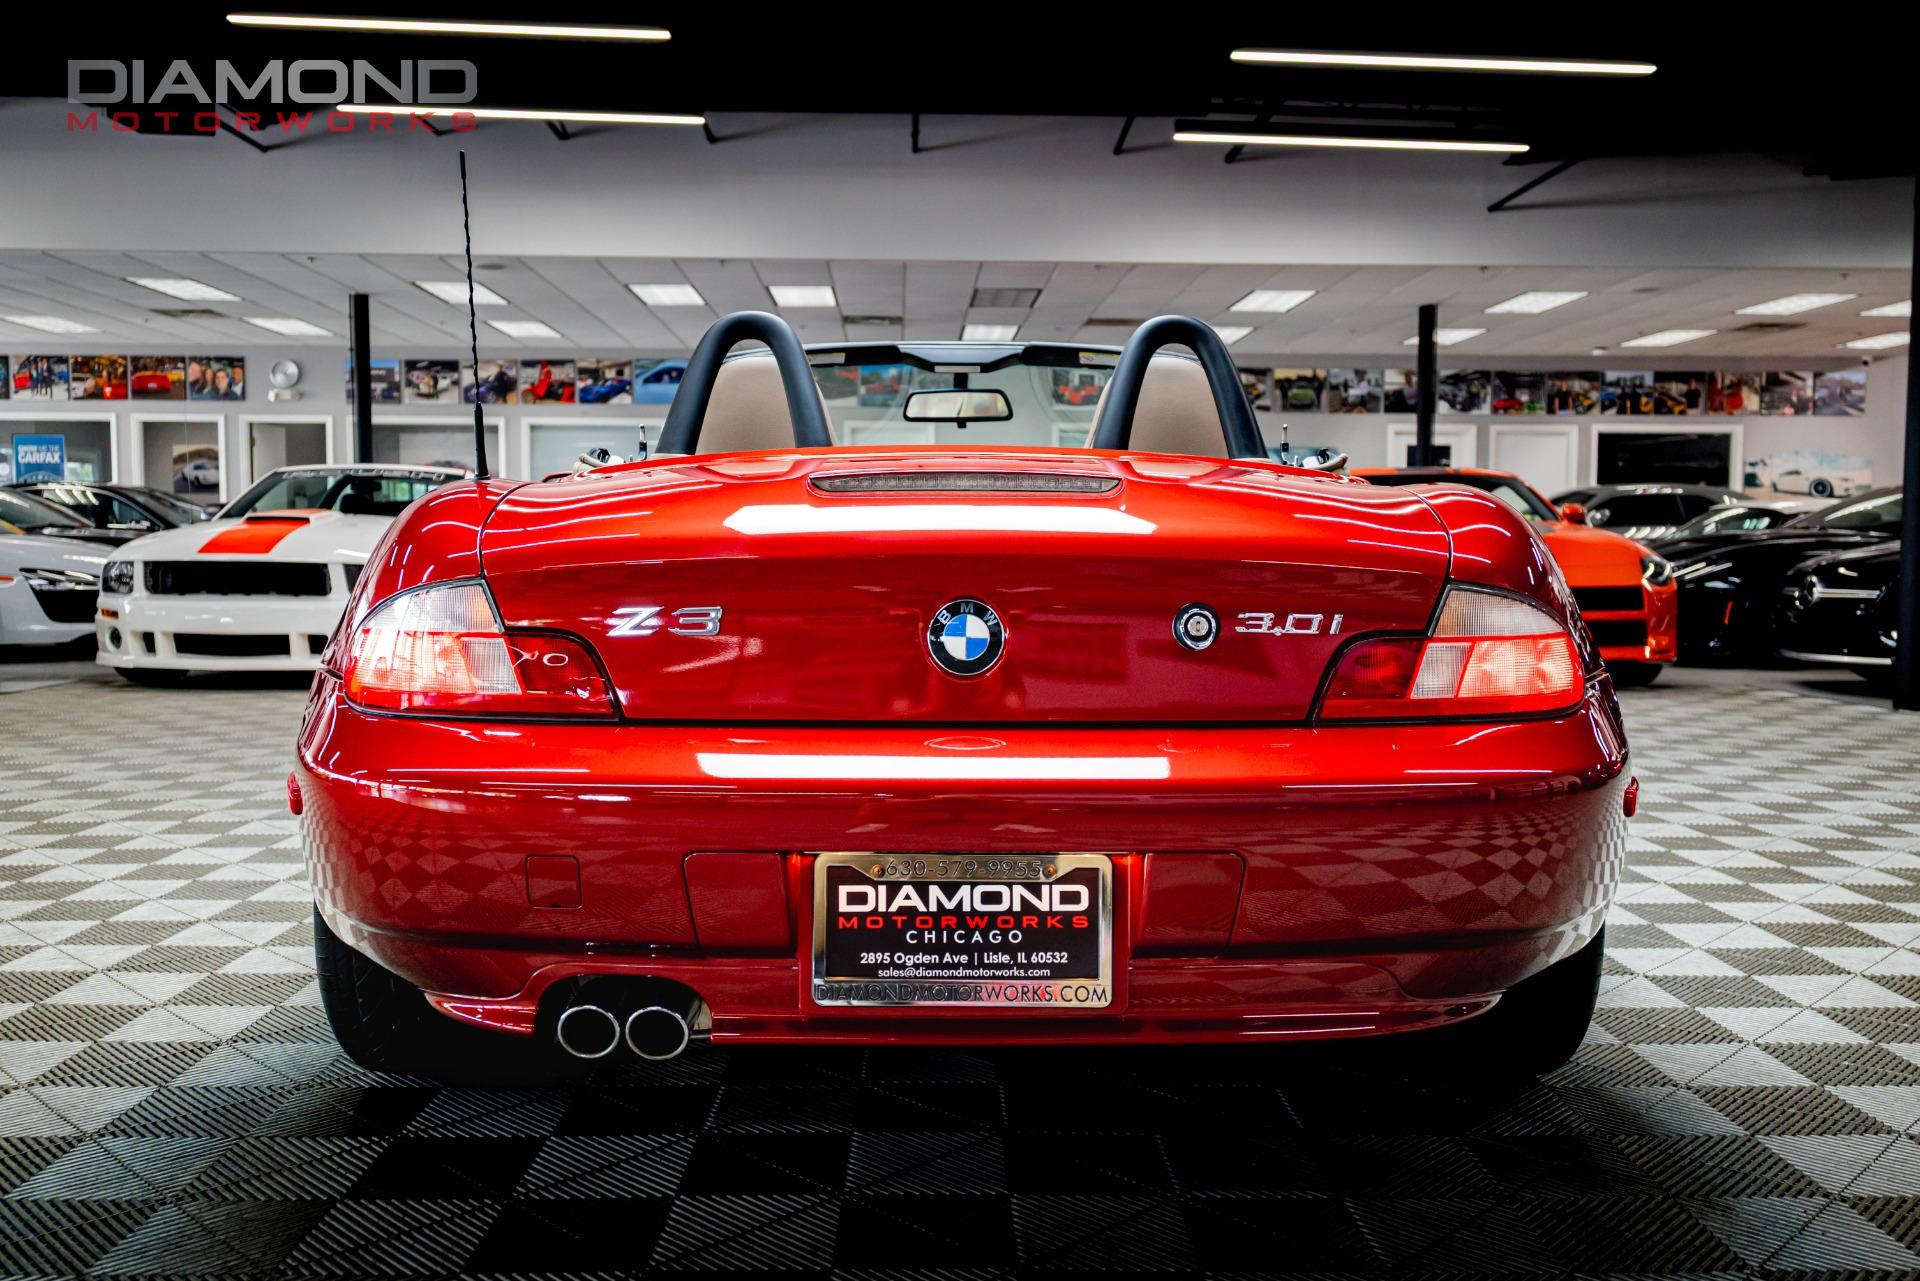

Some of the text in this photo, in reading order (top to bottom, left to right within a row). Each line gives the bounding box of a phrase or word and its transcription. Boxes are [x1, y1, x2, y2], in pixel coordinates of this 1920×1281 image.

[18, 451, 61, 464] CARFAX
[605, 606, 723, 636] Z3
[937, 602, 998, 625] BMW
[886, 859, 1042, 878] 630-579-9955
[838, 884, 1090, 912] DIAMOND
[838, 915, 1089, 929] MOTORWORKS
[905, 930, 1023, 944] CHICAGO
[860, 952, 891, 964] 2895
[894, 952, 939, 966] Ogden
[942, 952, 968, 964] Ave
[983, 952, 1014, 965] Lisle,
[1017, 952, 1027, 963] IL
[1030, 952, 1068, 964] 60532
[878, 966, 1051, 978] sales@diamondmotorworks.com
[816, 983, 1108, 1003] DIAMONDMOTORWORKS.COM
